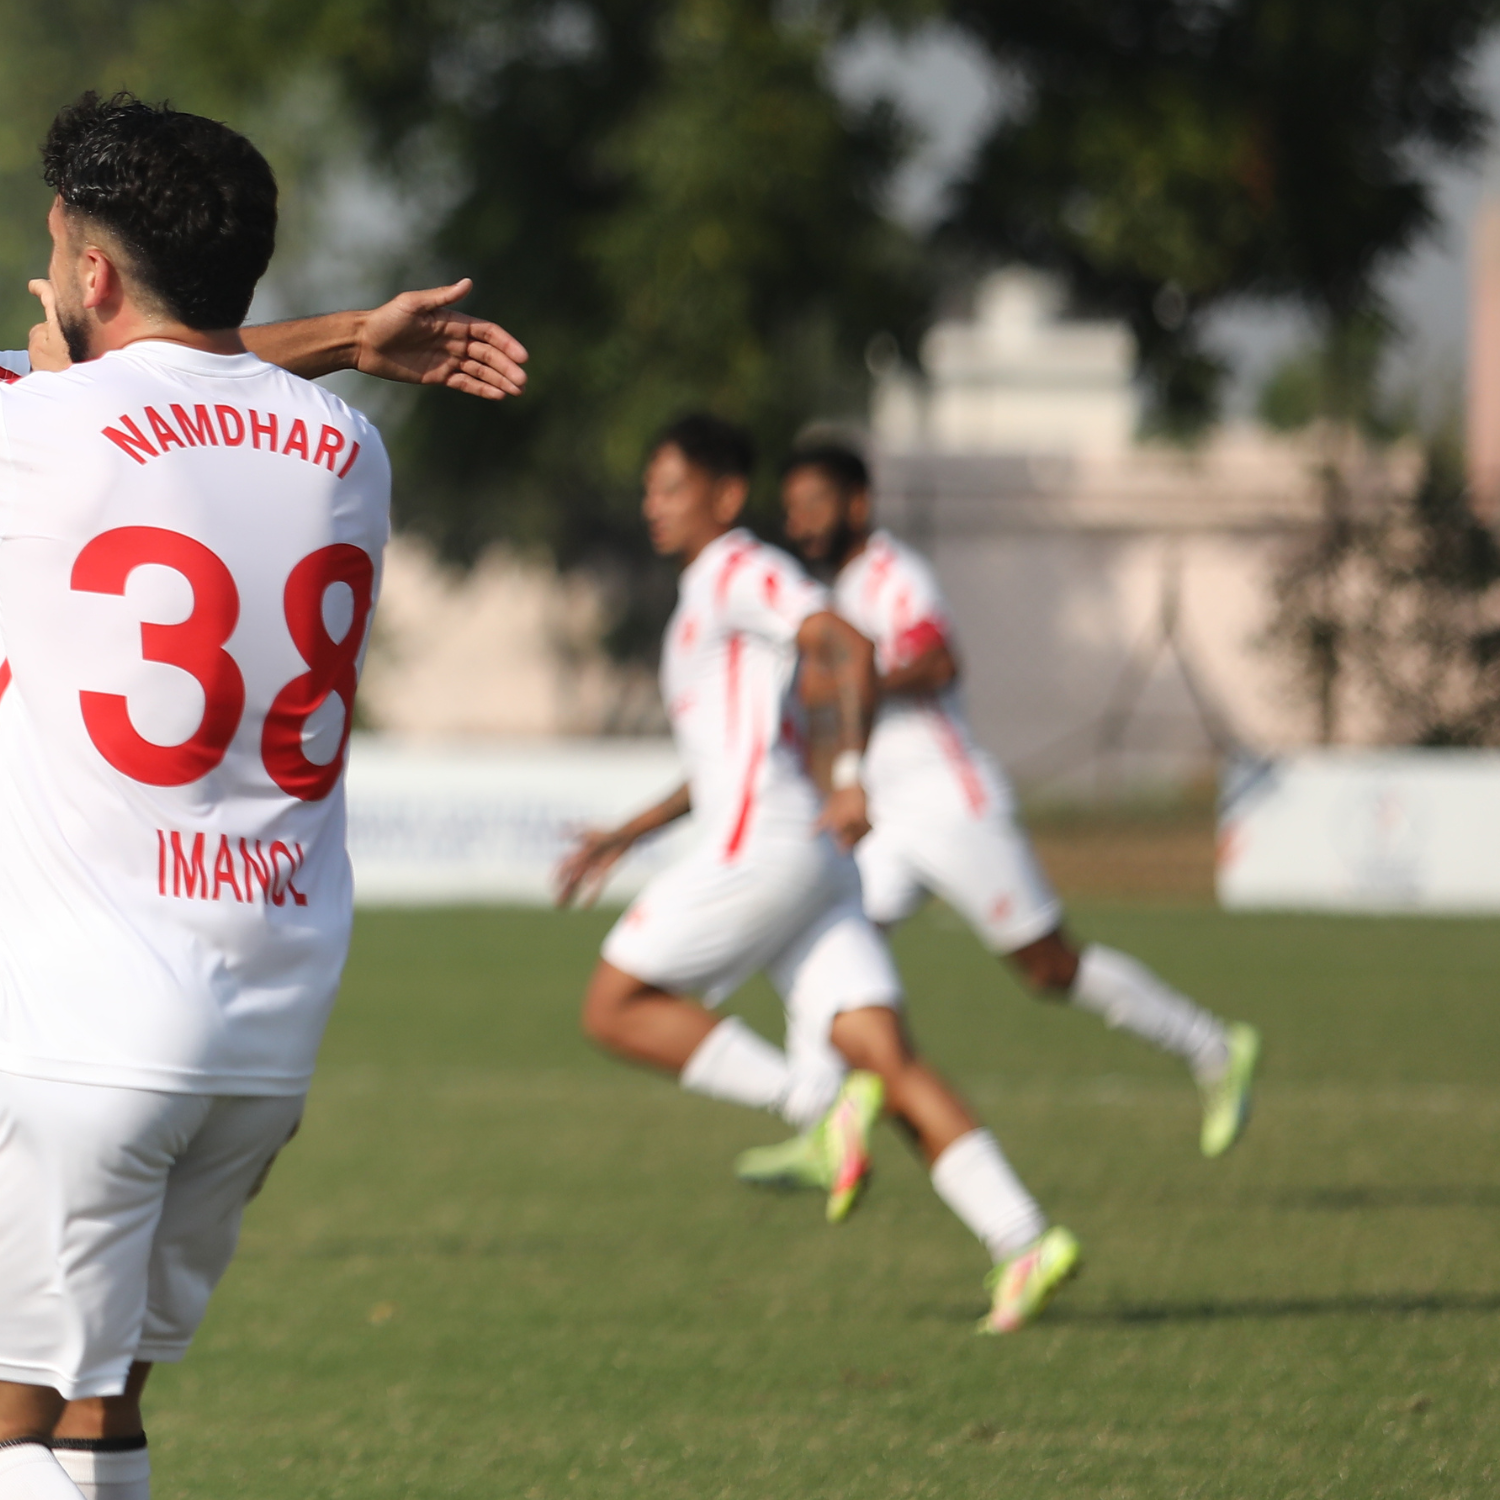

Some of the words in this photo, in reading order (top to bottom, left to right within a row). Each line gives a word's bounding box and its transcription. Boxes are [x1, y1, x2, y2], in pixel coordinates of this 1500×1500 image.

[101, 403, 360, 479] NAMDHARI
[70, 525, 374, 802] 38
[156, 829, 308, 907] IMANOL
